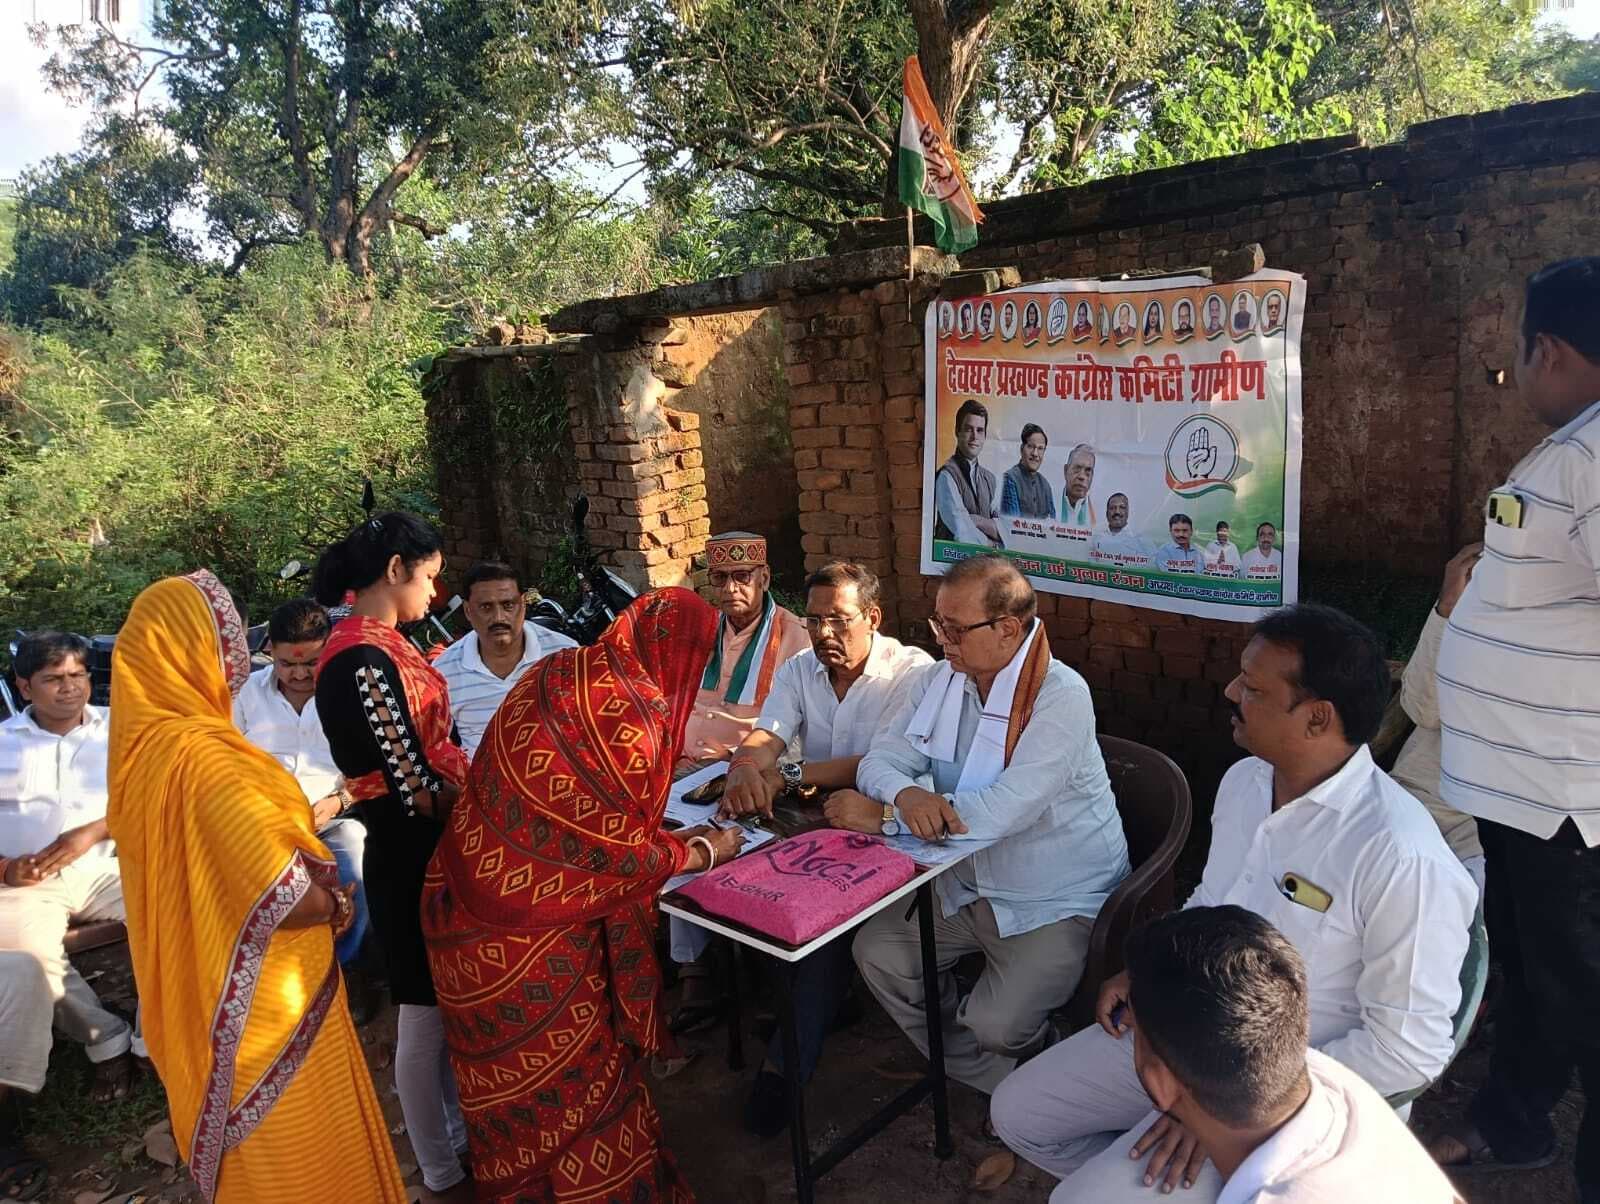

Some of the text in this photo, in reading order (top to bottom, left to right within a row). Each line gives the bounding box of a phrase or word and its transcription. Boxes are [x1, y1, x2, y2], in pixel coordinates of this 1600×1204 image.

[946, 348, 1267, 404] देवघर प्रखण्ड कांग्रेस कमिटी ग्रामीण
[1071, 566, 1108, 584] गुलाब
[1112, 570, 1145, 588] रंजन
